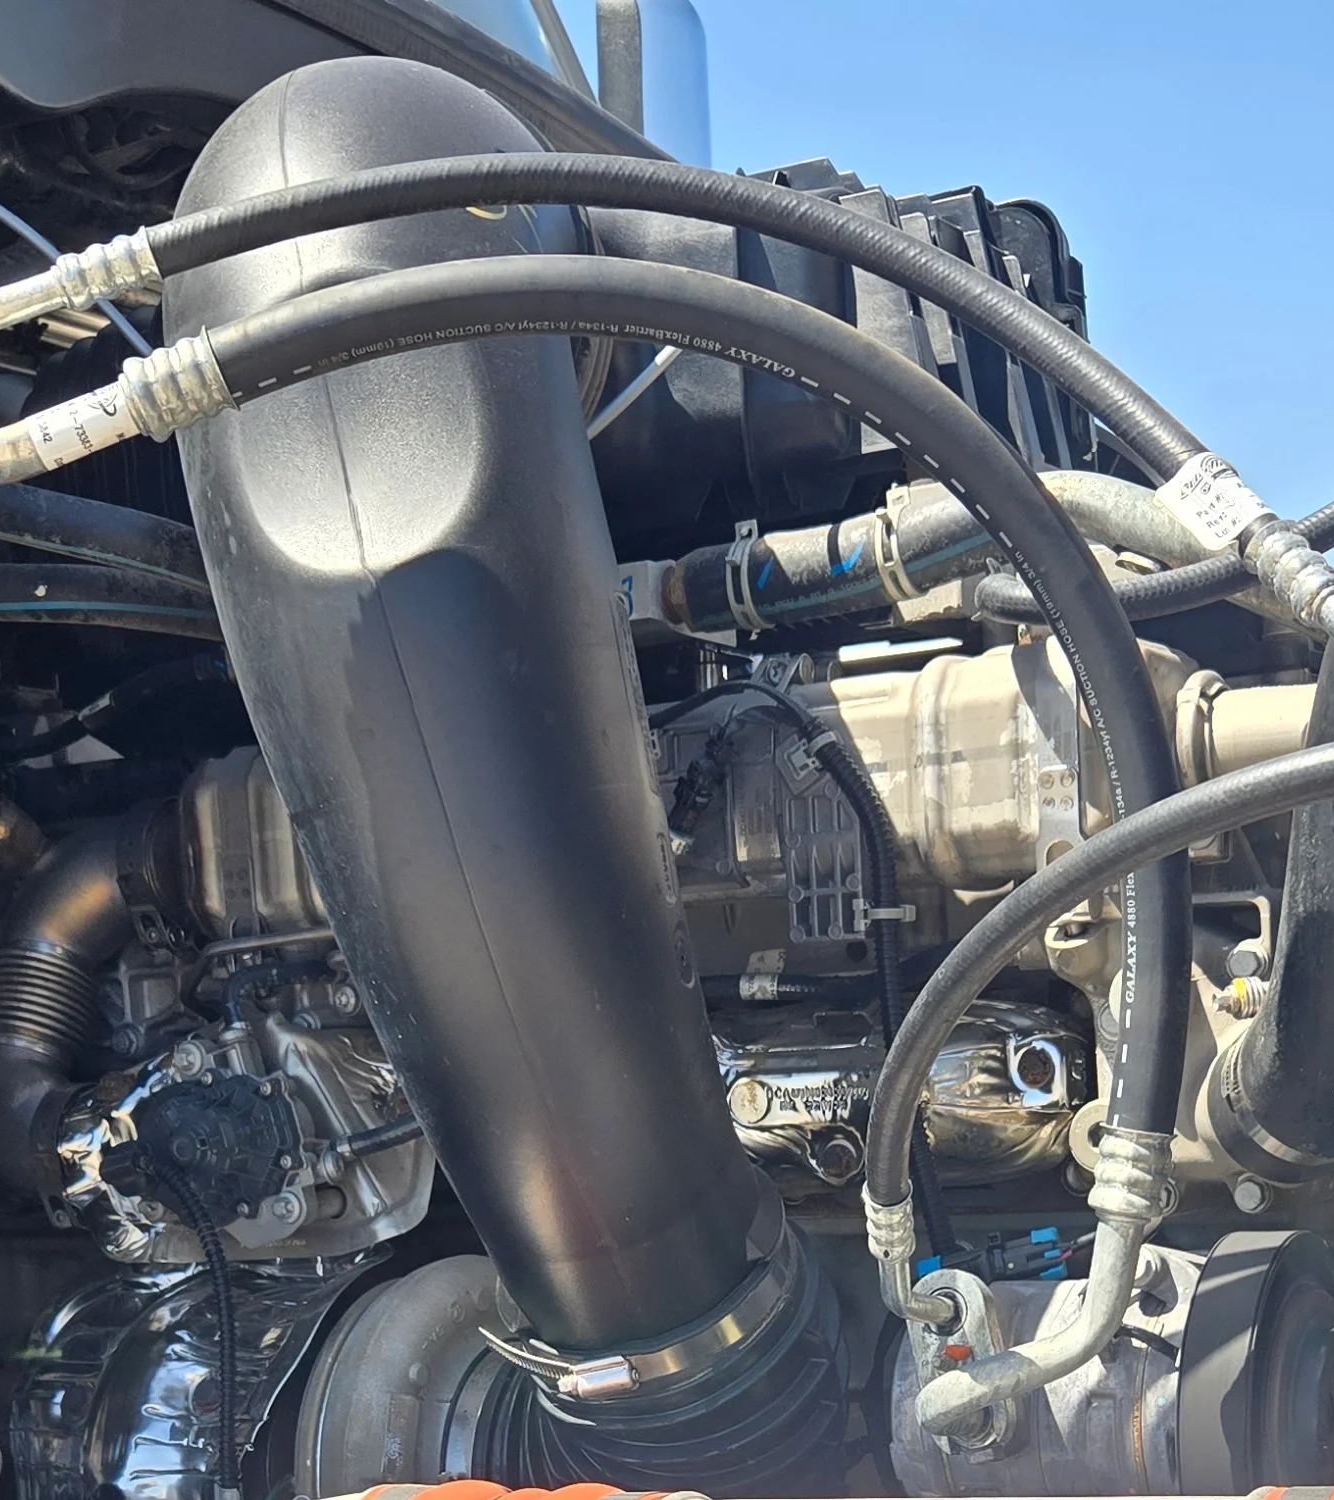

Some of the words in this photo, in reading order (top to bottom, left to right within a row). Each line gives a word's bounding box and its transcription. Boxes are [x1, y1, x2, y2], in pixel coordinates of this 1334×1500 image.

[436, 324, 492, 339] SUCTION
[495, 322, 516, 332] A/C
[518, 320, 568, 331] R-1234yf
[578, 321, 619, 333] R-134a
[624, 324, 690, 345] FlexBarrier
[398, 331, 433, 346] HOSE
[693, 337, 722, 352] 4880
[725, 346, 796, 378] GALAXY
[1021, 562, 1036, 579] 3/4
[1033, 579, 1061, 619] (19mm)
[1056, 620, 1076, 654] HOSE
[1072, 654, 1096, 707] SUCTION
[1093, 709, 1106, 729] A/C
[1127, 900, 1136, 928] 4880
[1125, 933, 1138, 1003] GALAXY
